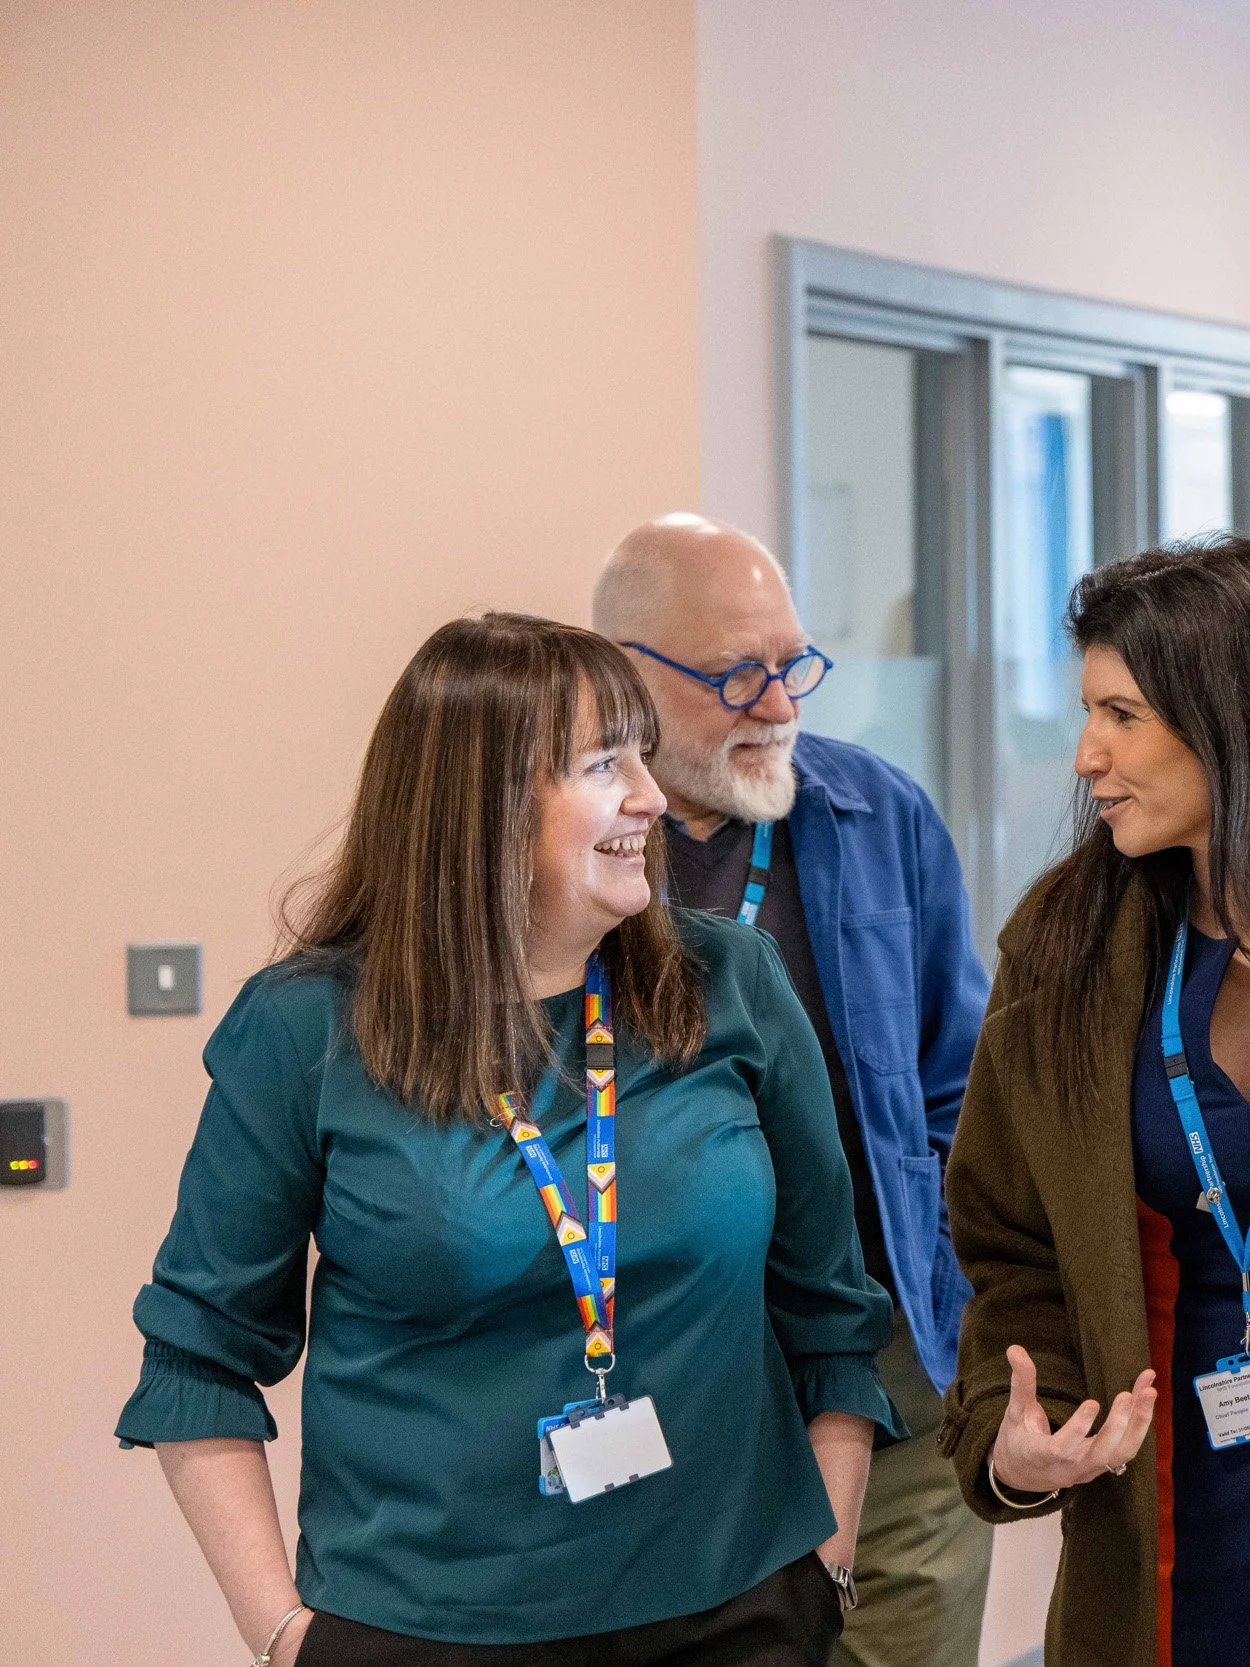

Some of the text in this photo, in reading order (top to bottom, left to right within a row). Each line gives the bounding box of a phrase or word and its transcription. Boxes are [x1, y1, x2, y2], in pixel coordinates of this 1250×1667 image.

[1189, 1132, 1203, 1154] NHS
[1200, 1155, 1229, 1229] Lincolns artnership
[1199, 1378, 1233, 1391] Lincolnshire
[1218, 1399, 1234, 1408] Amy
